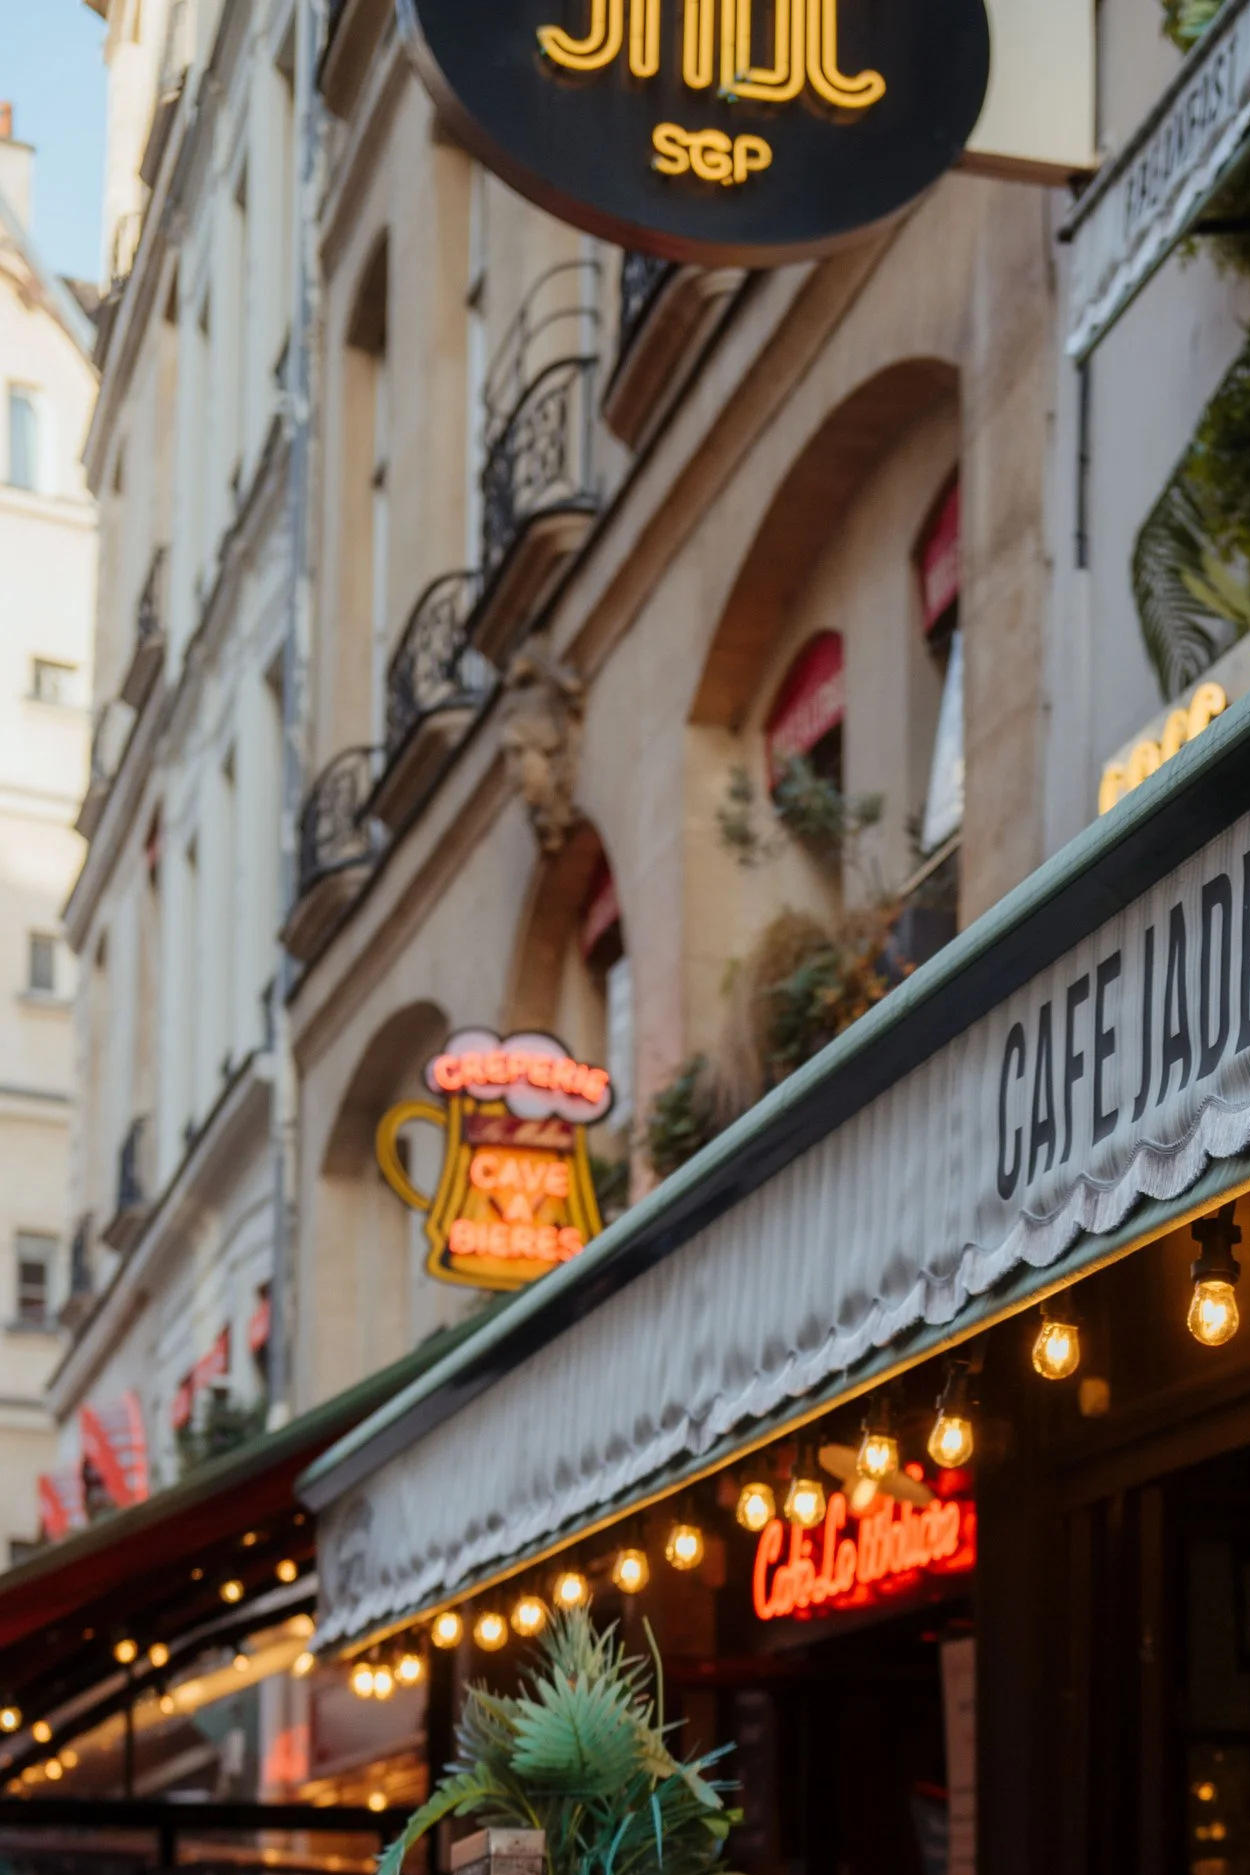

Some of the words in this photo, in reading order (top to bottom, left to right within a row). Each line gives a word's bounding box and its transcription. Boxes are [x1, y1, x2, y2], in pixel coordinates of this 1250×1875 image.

[651, 122, 772, 184] SGP
[996, 948, 1121, 1201] CAFE
[470, 1152, 569, 1197] CAVE
